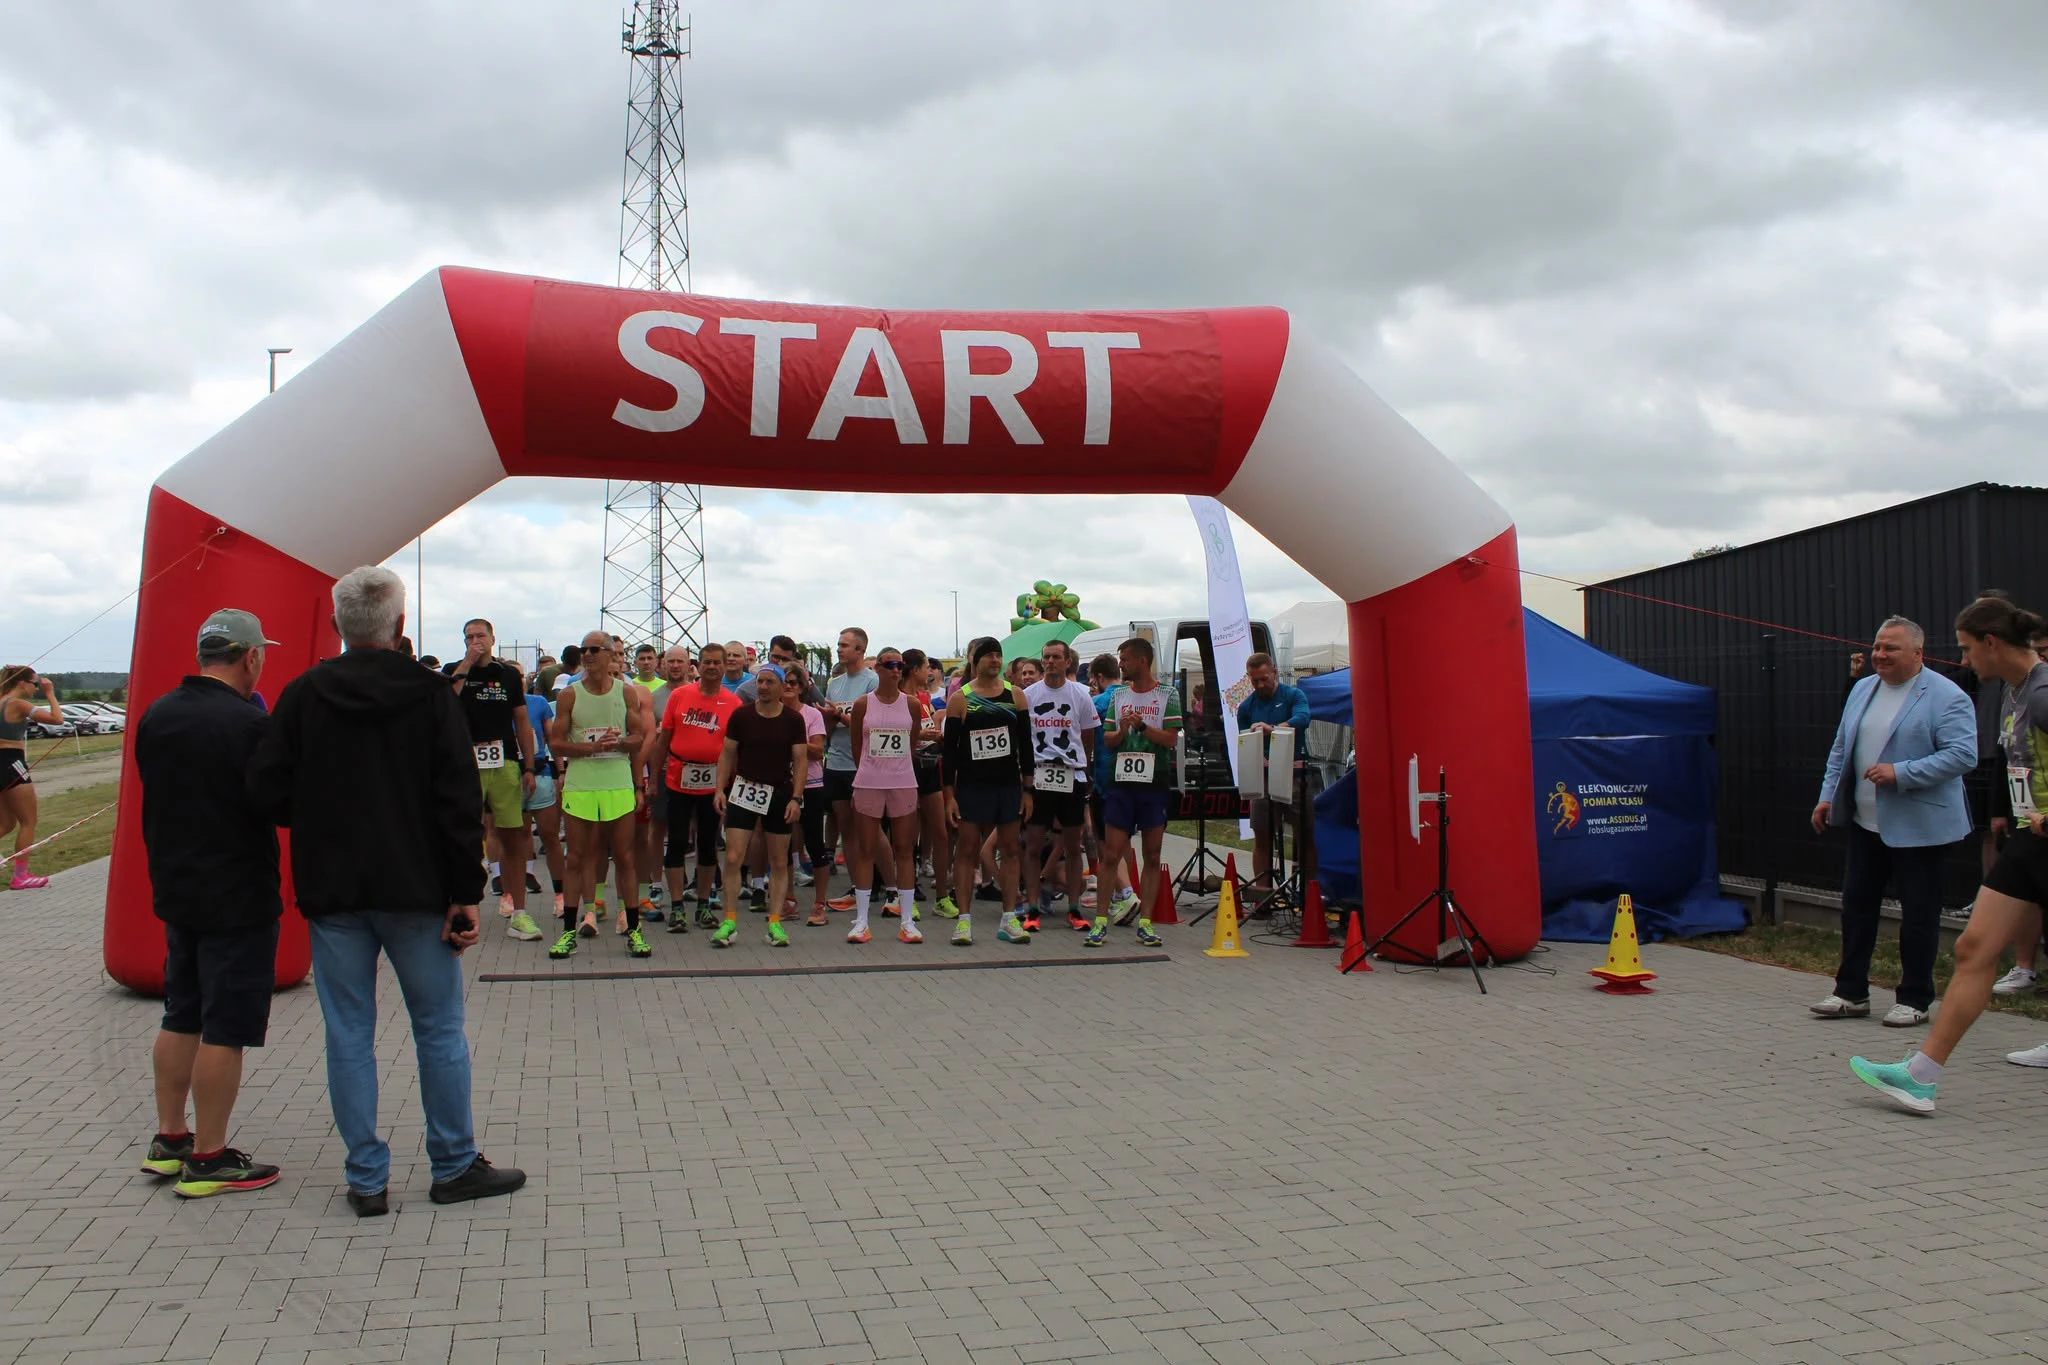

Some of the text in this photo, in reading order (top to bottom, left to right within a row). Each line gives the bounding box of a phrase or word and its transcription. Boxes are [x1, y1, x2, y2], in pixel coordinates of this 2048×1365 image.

[611, 310, 1141, 445] START
[879, 734, 902, 750] 78
[975, 733, 1008, 751] 136
[477, 746, 500, 761] 58
[1123, 758, 1145, 774] 80
[690, 769, 712, 783] 36
[1044, 768, 1066, 784] 35
[737, 783, 768, 806] 133
[1583, 797, 1618, 807] POMIAR
[1587, 814, 1647, 825] www.ASSIDUS.pl
